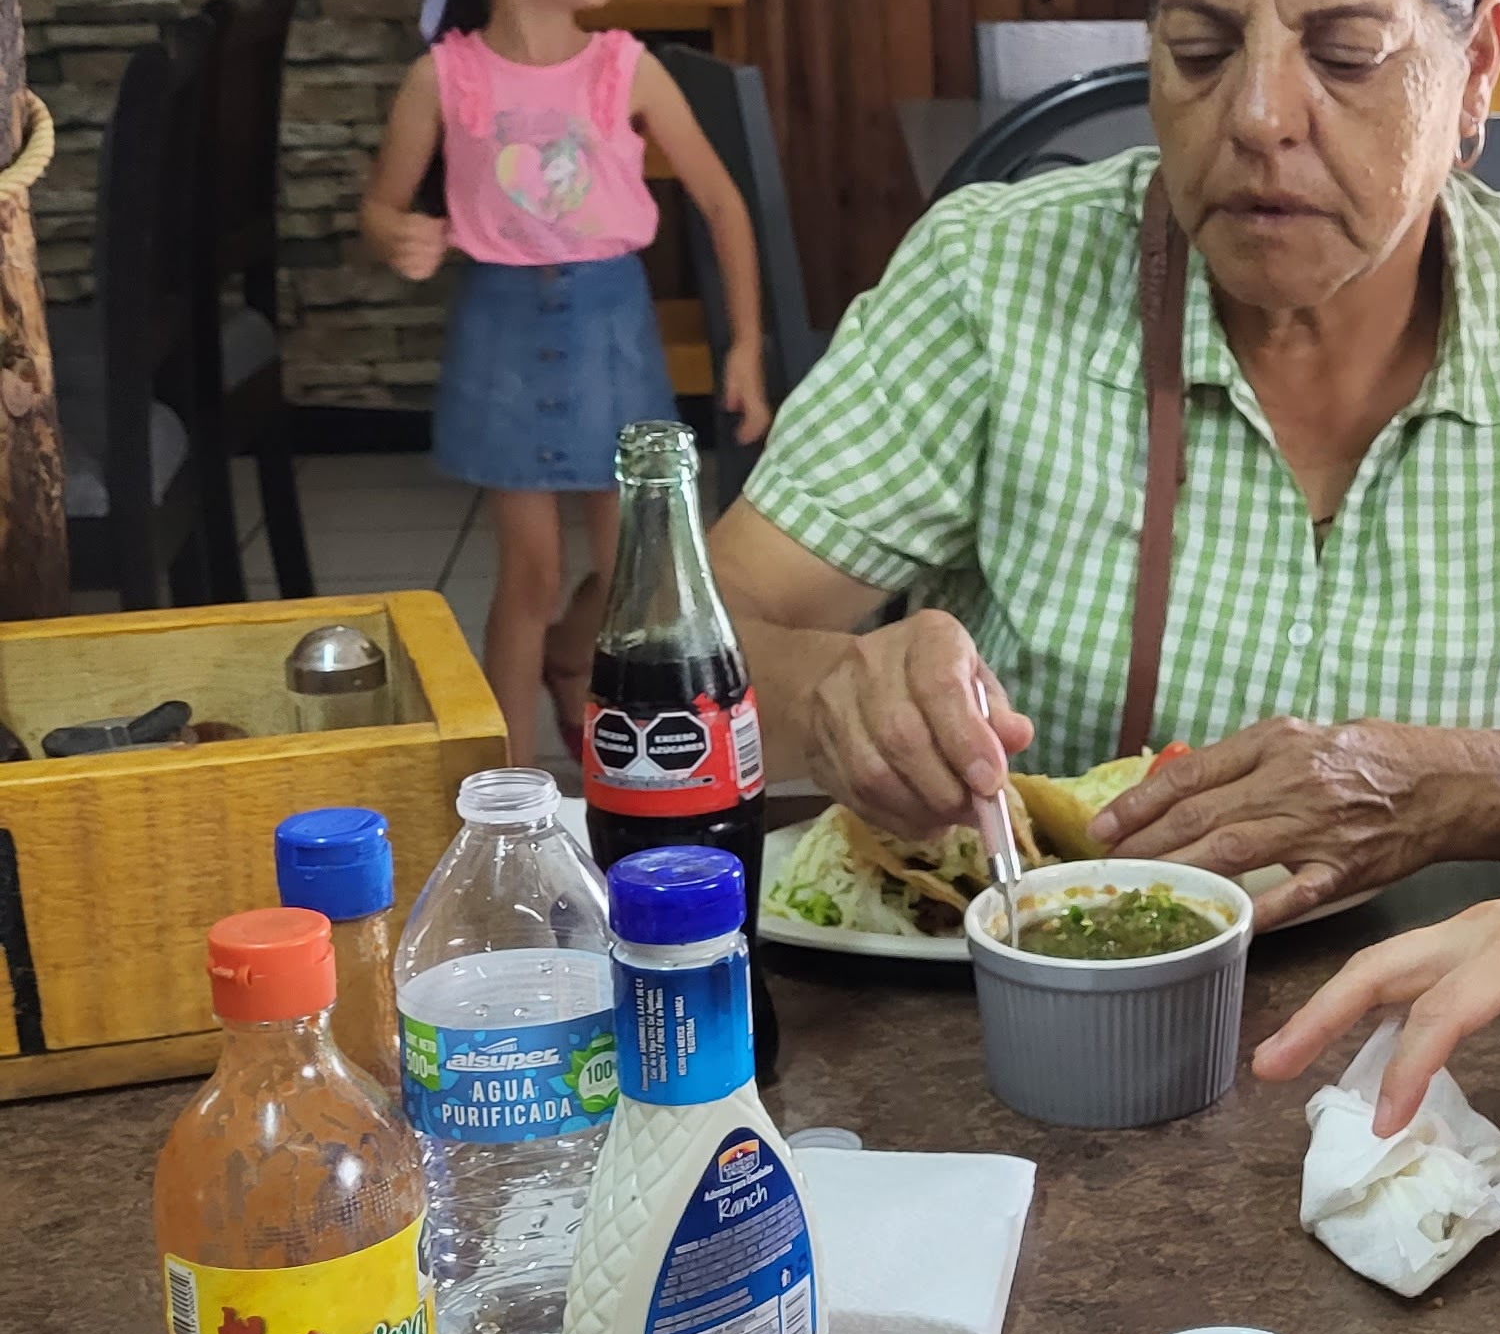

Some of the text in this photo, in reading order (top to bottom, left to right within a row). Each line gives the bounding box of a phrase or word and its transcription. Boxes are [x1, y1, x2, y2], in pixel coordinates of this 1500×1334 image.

[450, 1048, 559, 1071] alsuper
[472, 1078, 535, 1103] AGUA
[442, 1097, 573, 1127] PURIFICADA
[718, 1183, 768, 1223] Ranch
